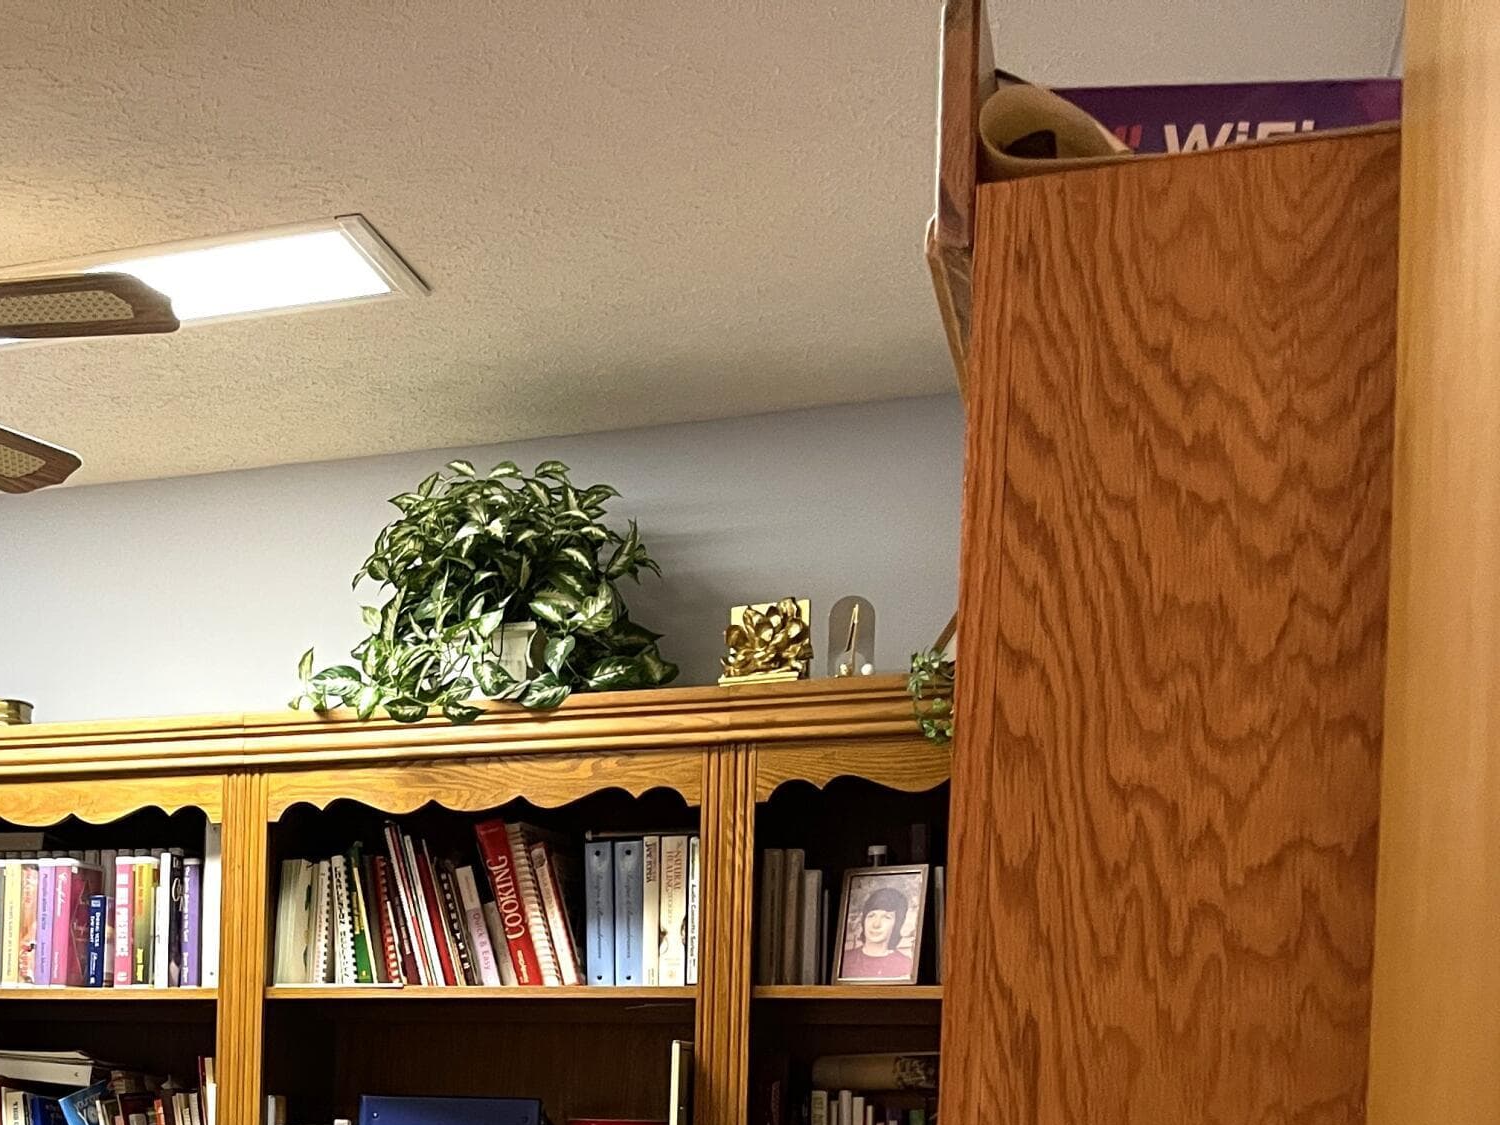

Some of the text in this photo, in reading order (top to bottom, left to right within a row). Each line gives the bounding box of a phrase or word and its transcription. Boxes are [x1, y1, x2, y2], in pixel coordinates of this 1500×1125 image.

[1163, 119, 1315, 154] Wi
[665, 851, 674, 892] HEALING
[674, 850, 682, 891] NATURAL
[486, 856, 525, 940] COOKING
[473, 913, 484, 938] Quick
[482, 950, 491, 971] Easy
